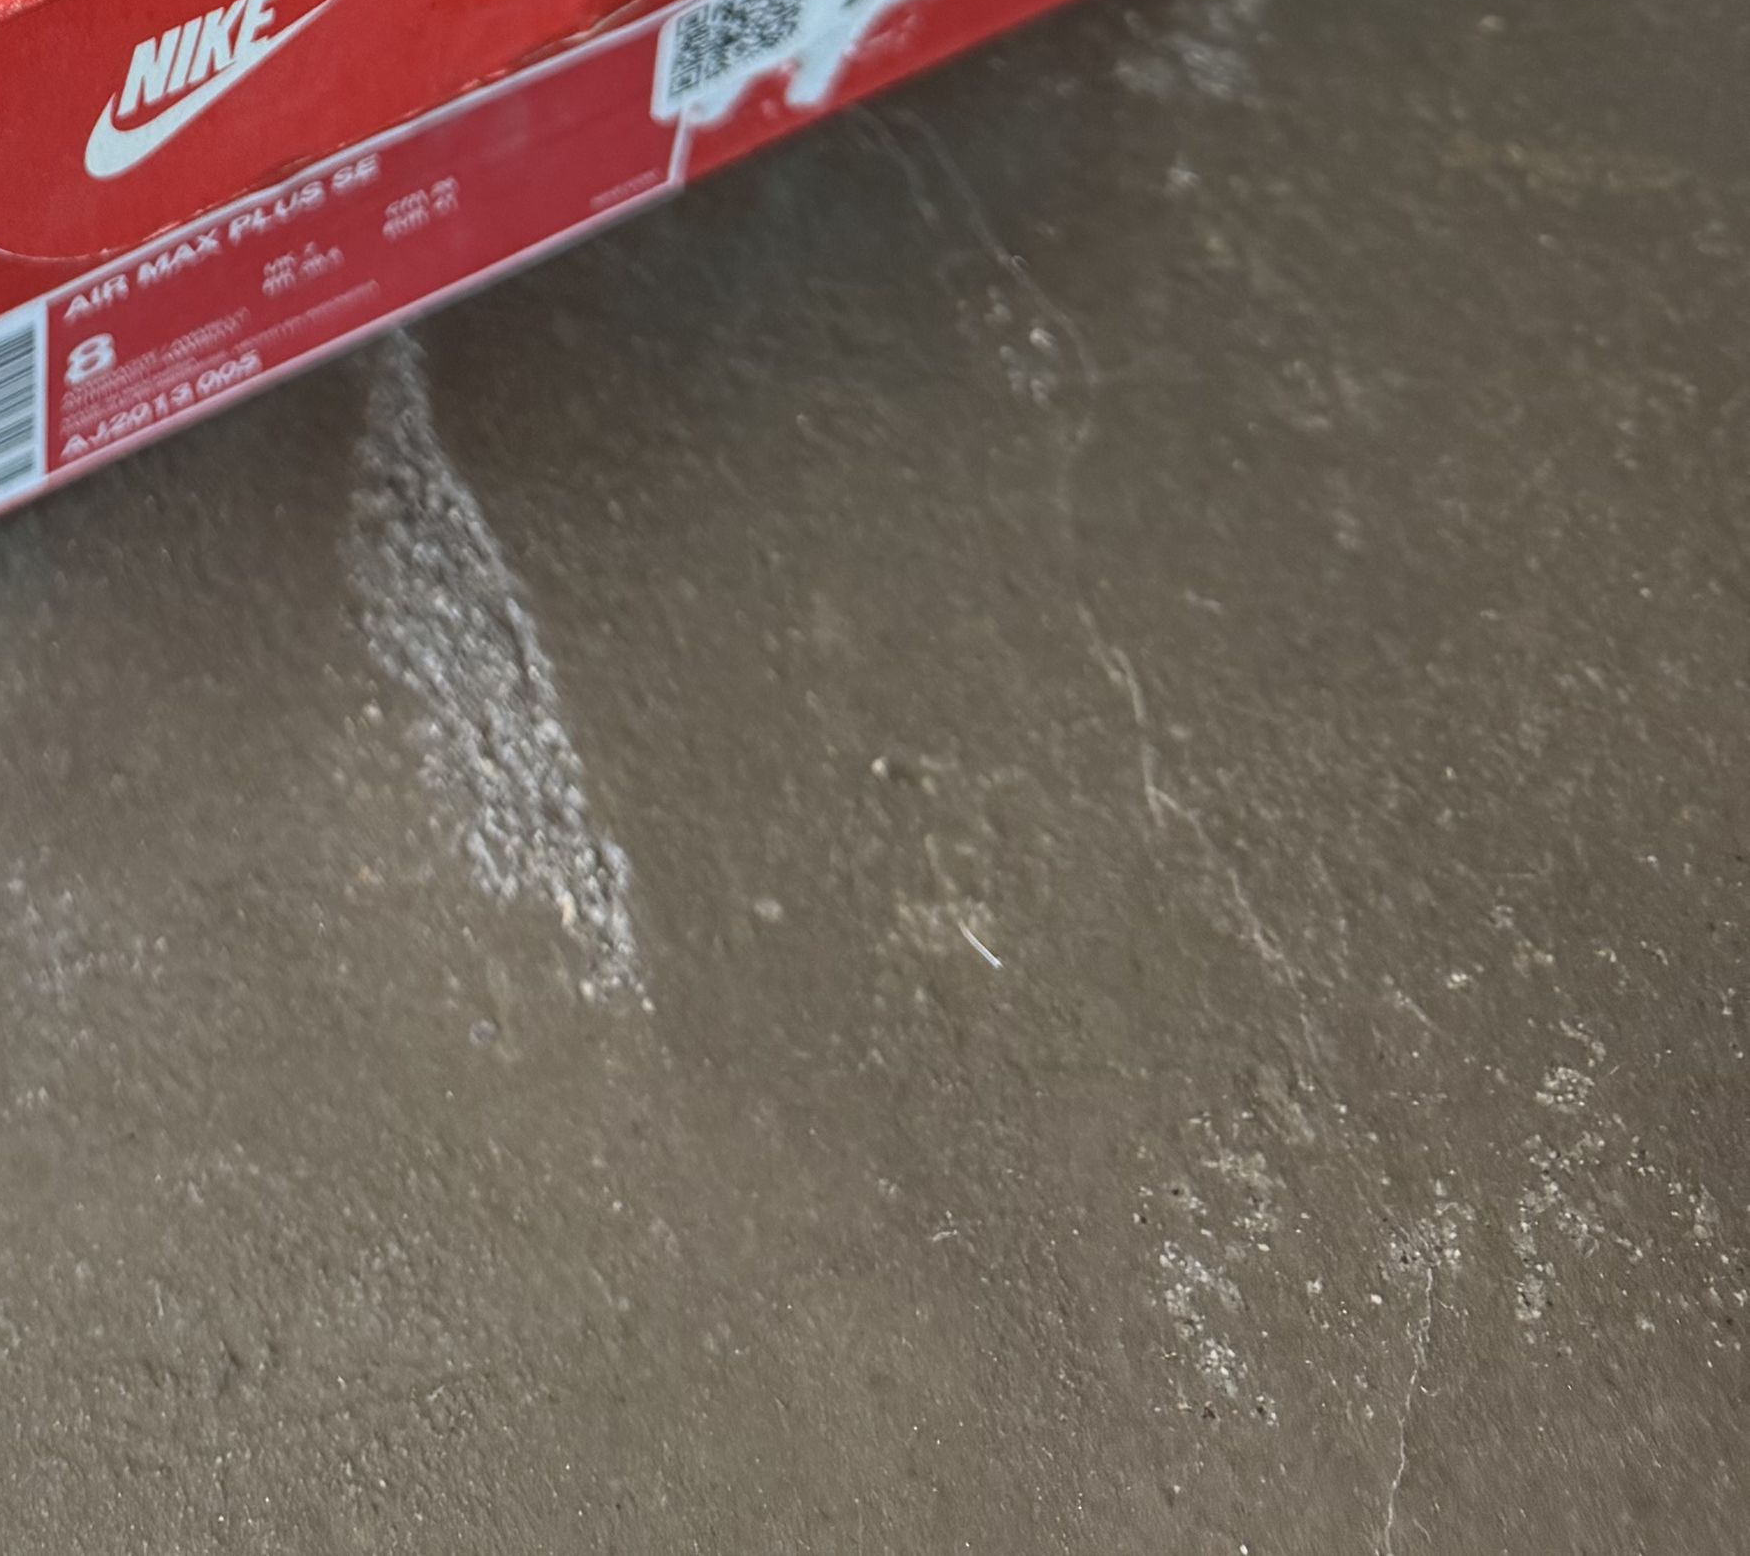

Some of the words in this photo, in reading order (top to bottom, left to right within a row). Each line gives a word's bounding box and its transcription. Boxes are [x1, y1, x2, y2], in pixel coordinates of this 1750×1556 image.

[62, 273, 129, 323] AIR
[136, 227, 220, 286] MAX
[228, 180, 325, 243] PLUS
[331, 152, 381, 194] SE
[64, 332, 117, 385] 8
